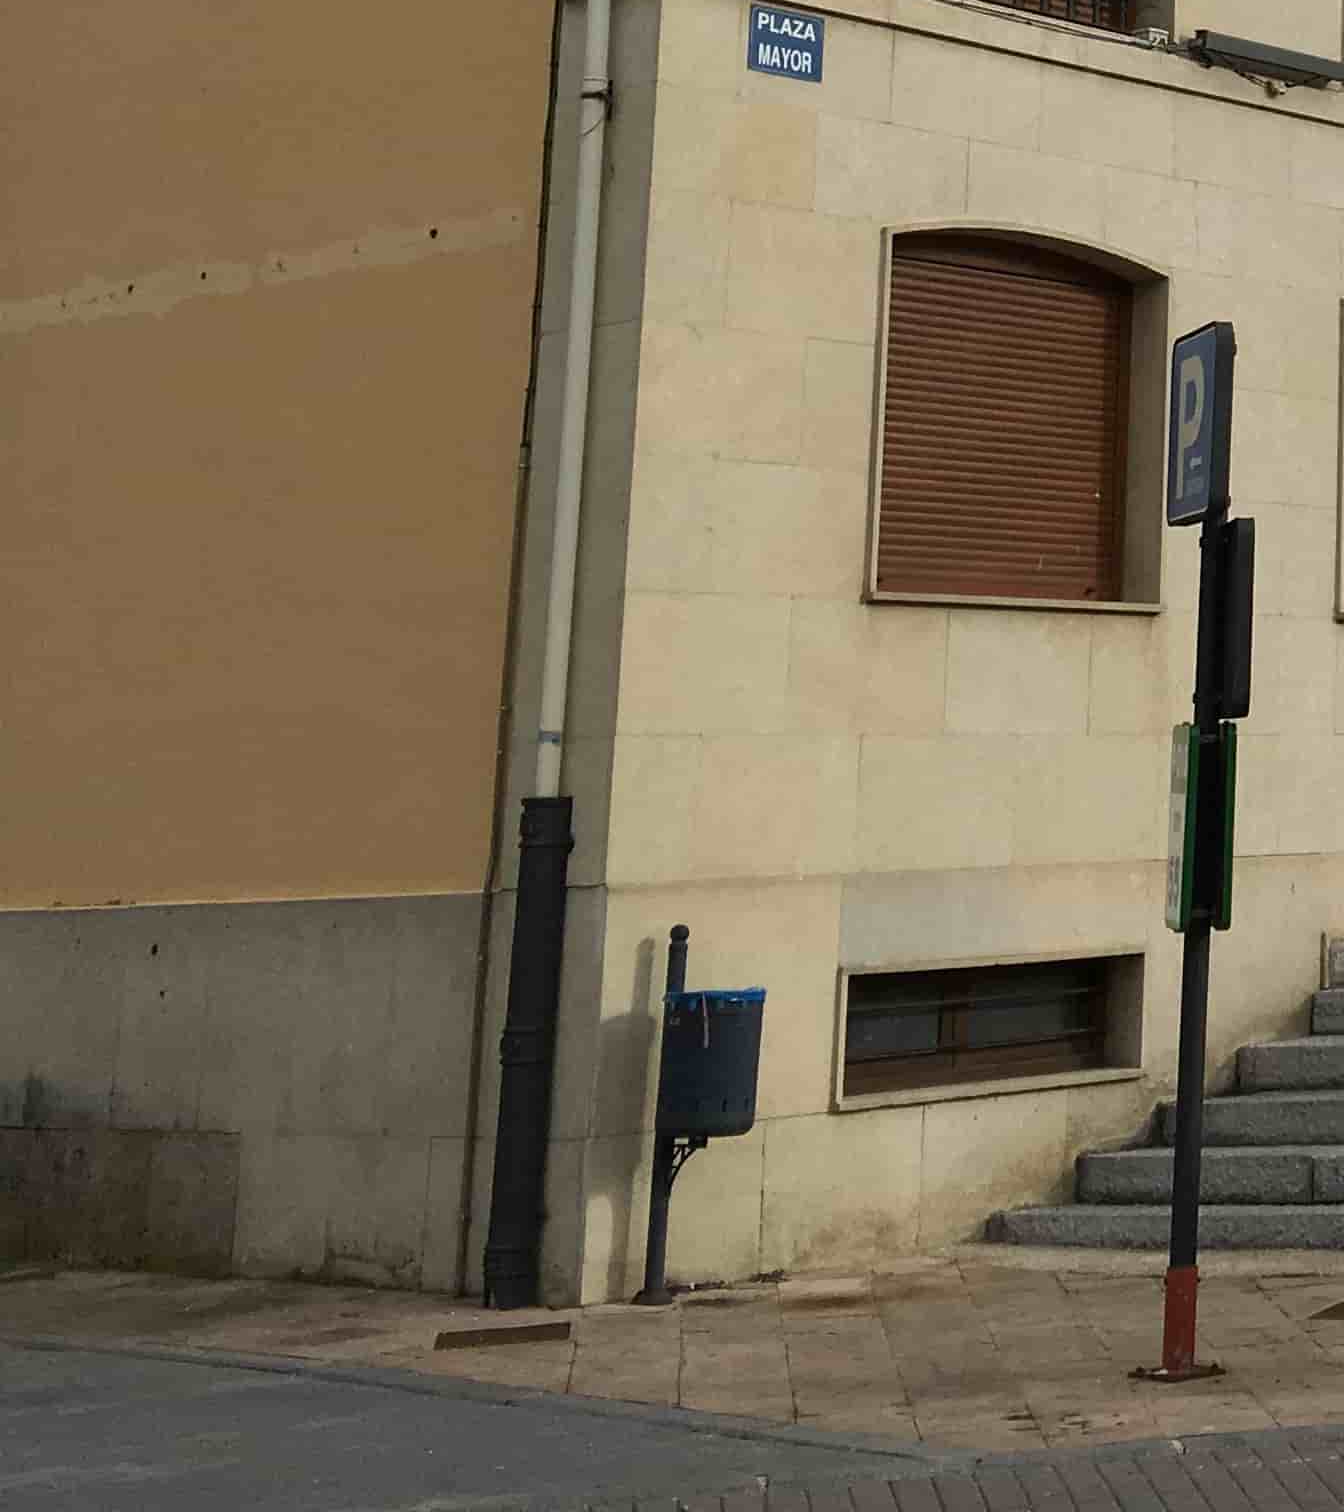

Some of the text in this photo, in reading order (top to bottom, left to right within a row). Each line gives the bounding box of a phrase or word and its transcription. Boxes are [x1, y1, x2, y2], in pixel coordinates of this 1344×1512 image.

[757, 11, 816, 42] PLAZA
[758, 43, 812, 74] MAYOR
[1175, 354, 1205, 502] P
